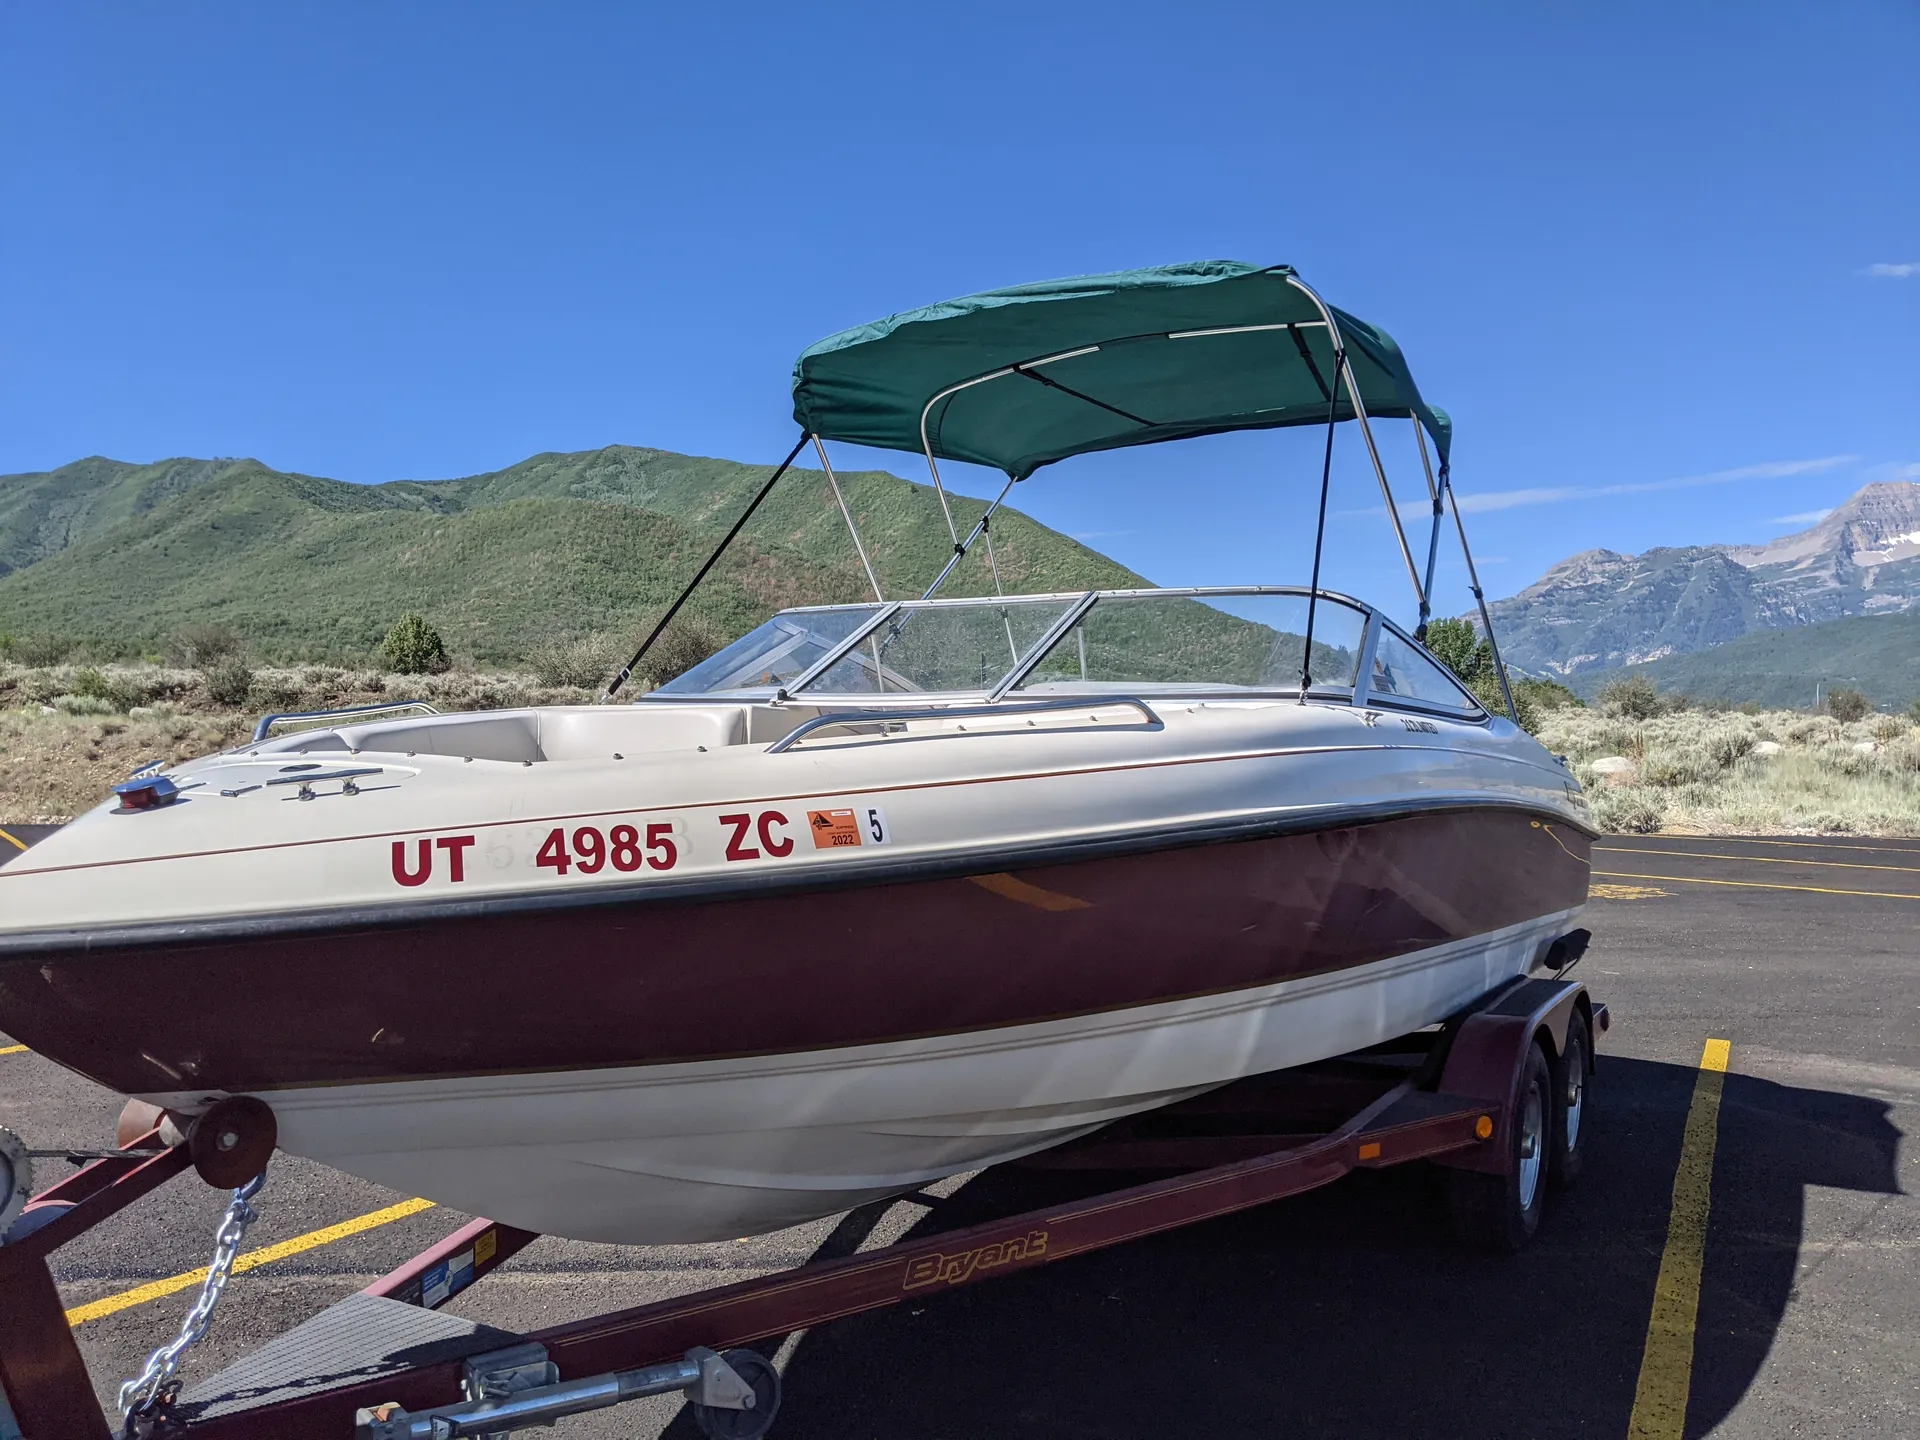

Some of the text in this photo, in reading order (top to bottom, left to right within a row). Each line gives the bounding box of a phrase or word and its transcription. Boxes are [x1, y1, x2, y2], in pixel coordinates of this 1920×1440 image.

[391, 835, 475, 887] UT
[535, 823, 678, 876] 4985
[718, 810, 795, 862] ZC
[831, 834, 855, 846] 2022
[867, 808, 883, 843] 5
[902, 1230, 1049, 1291] Bryant
